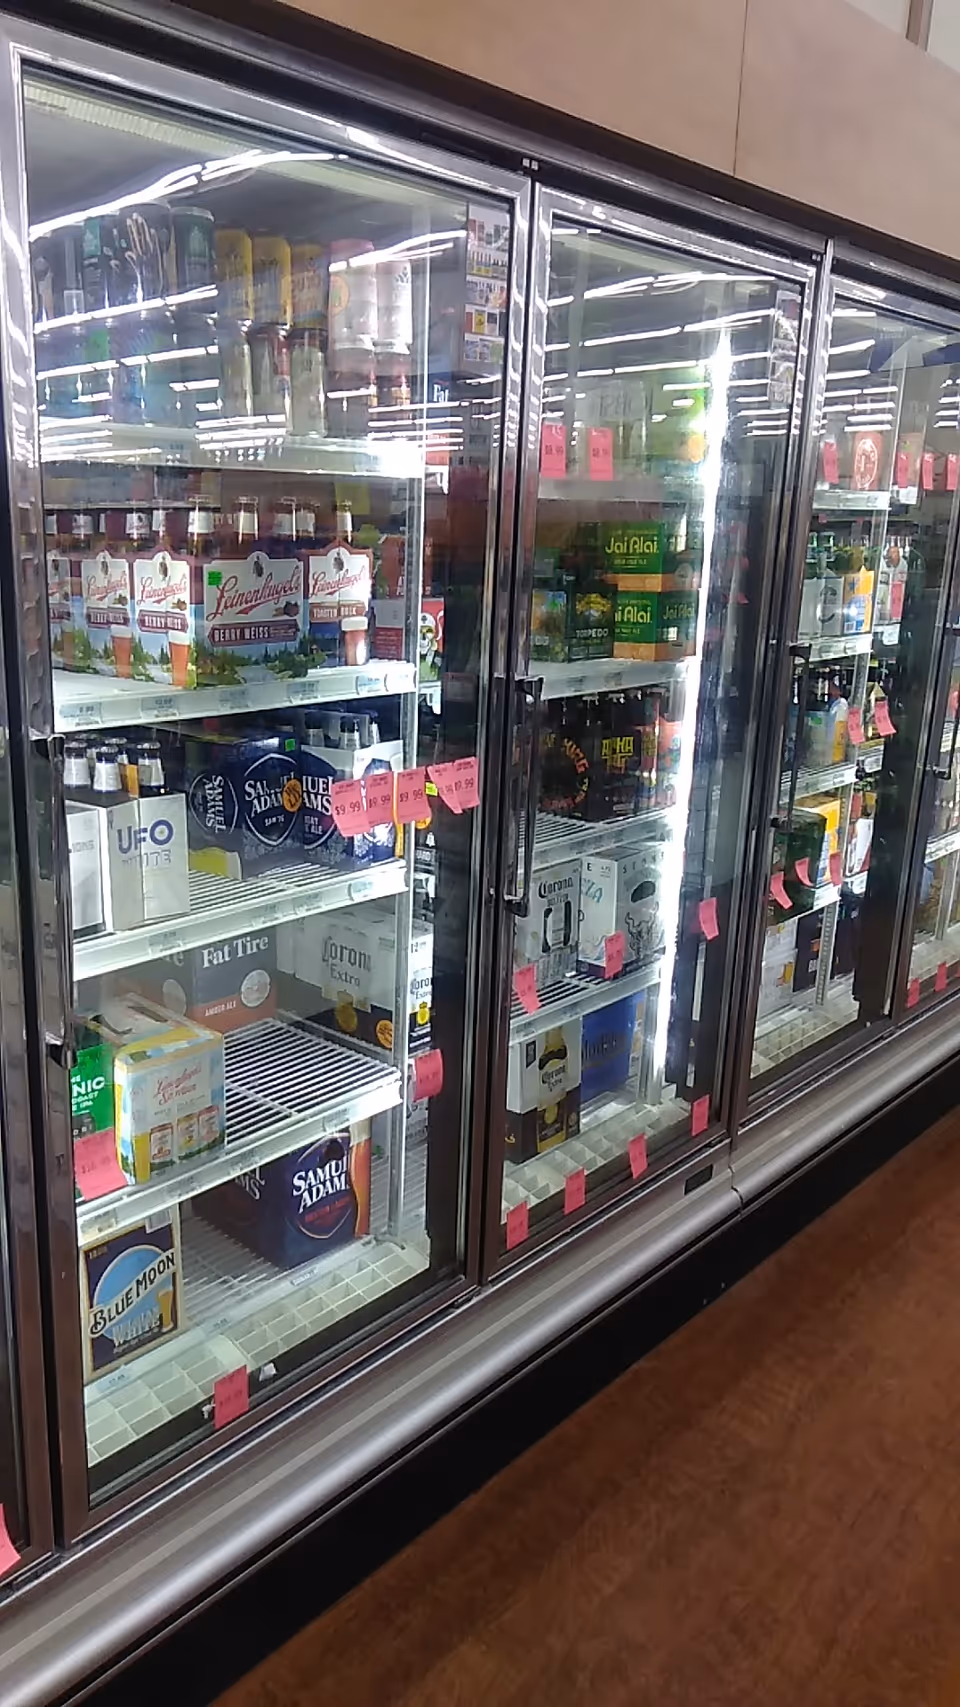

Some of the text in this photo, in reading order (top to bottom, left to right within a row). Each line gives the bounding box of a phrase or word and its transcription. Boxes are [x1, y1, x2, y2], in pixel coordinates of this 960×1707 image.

[605, 536, 658, 553] Jai Alai
[214, 628, 241, 642] BERRY
[244, 626, 269, 640] WEISS
[212, 774, 226, 834] SAMUEL
[117, 819, 174, 854] UFO
[538, 876, 573, 899] Corona
[201, 945, 232, 968] Fat
[233, 936, 269, 958] Tire
[292, 1155, 349, 1197] SAMU
[299, 1173, 350, 1214] ADAM
[90, 1252, 176, 1335] BLUE MOON
